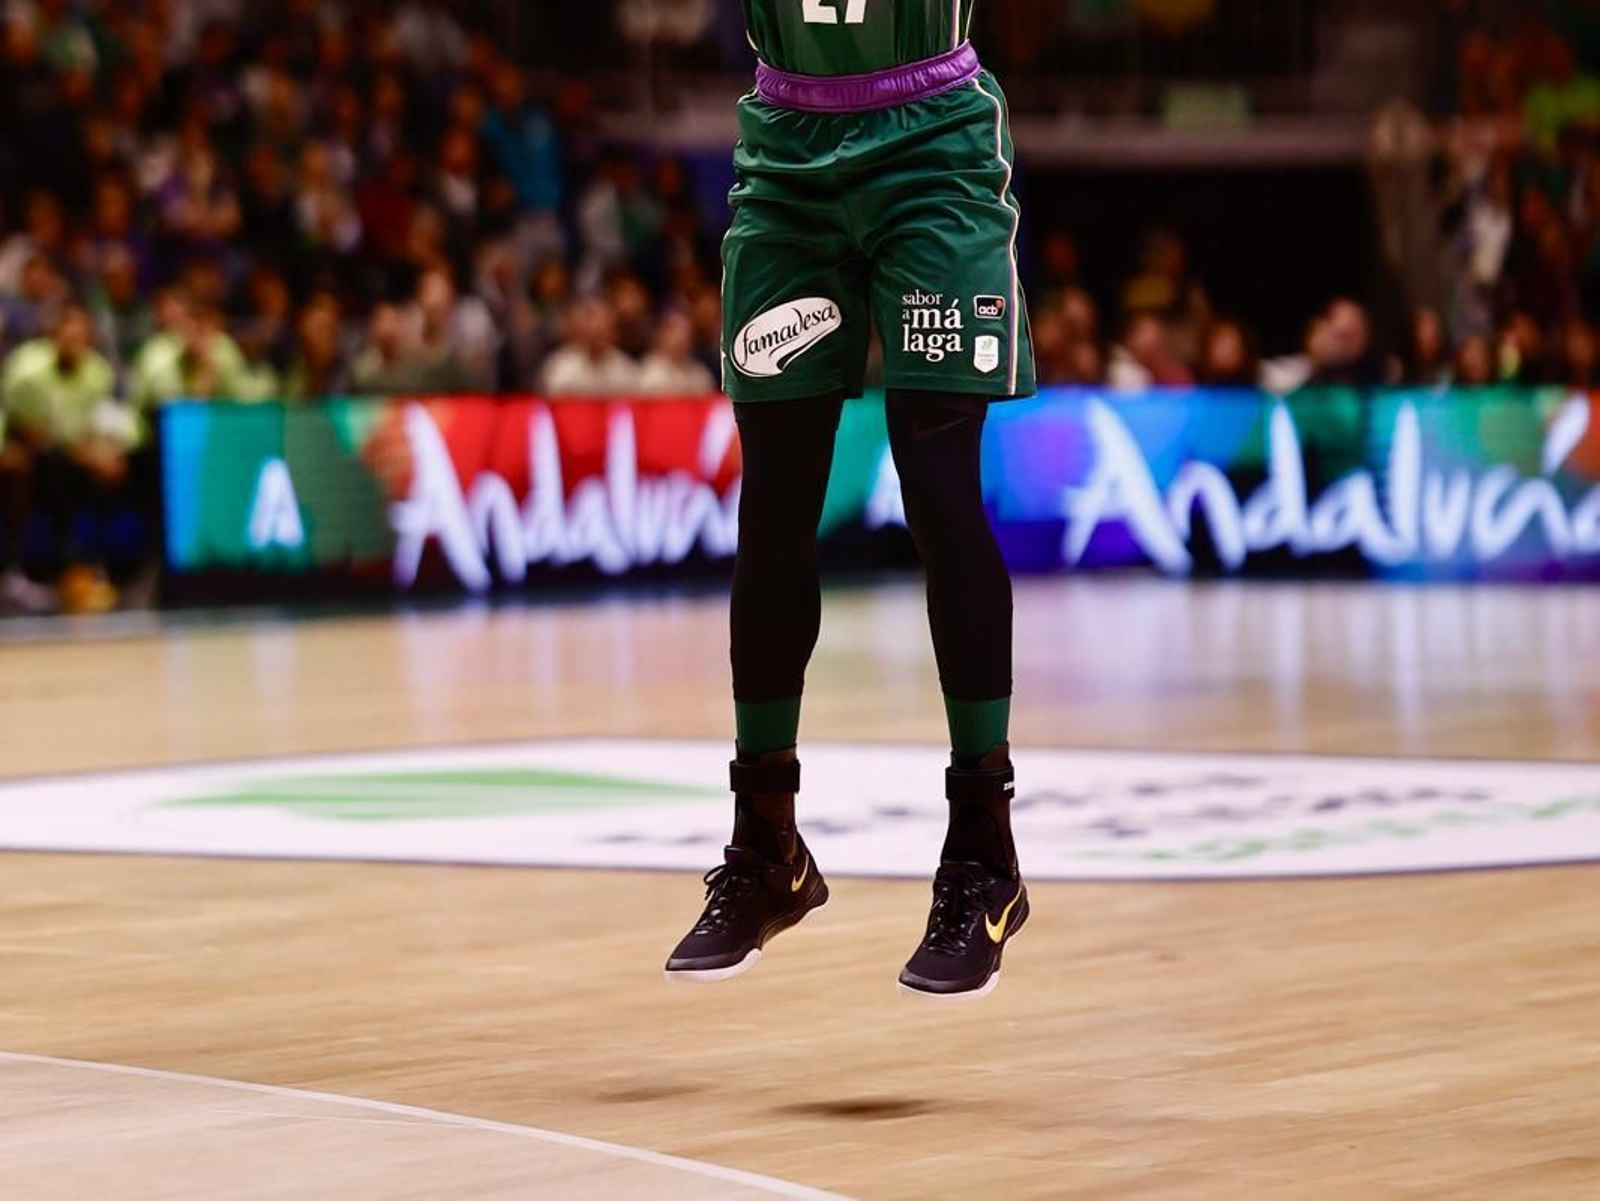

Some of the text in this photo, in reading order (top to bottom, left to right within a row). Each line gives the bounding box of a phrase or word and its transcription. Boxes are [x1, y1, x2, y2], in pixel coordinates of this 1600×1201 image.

[902, 289, 943, 305] sabor
[978, 304, 998, 316] acb
[902, 298, 965, 329] a má
[741, 305, 836, 367] famadesa
[902, 323, 965, 362] laga
